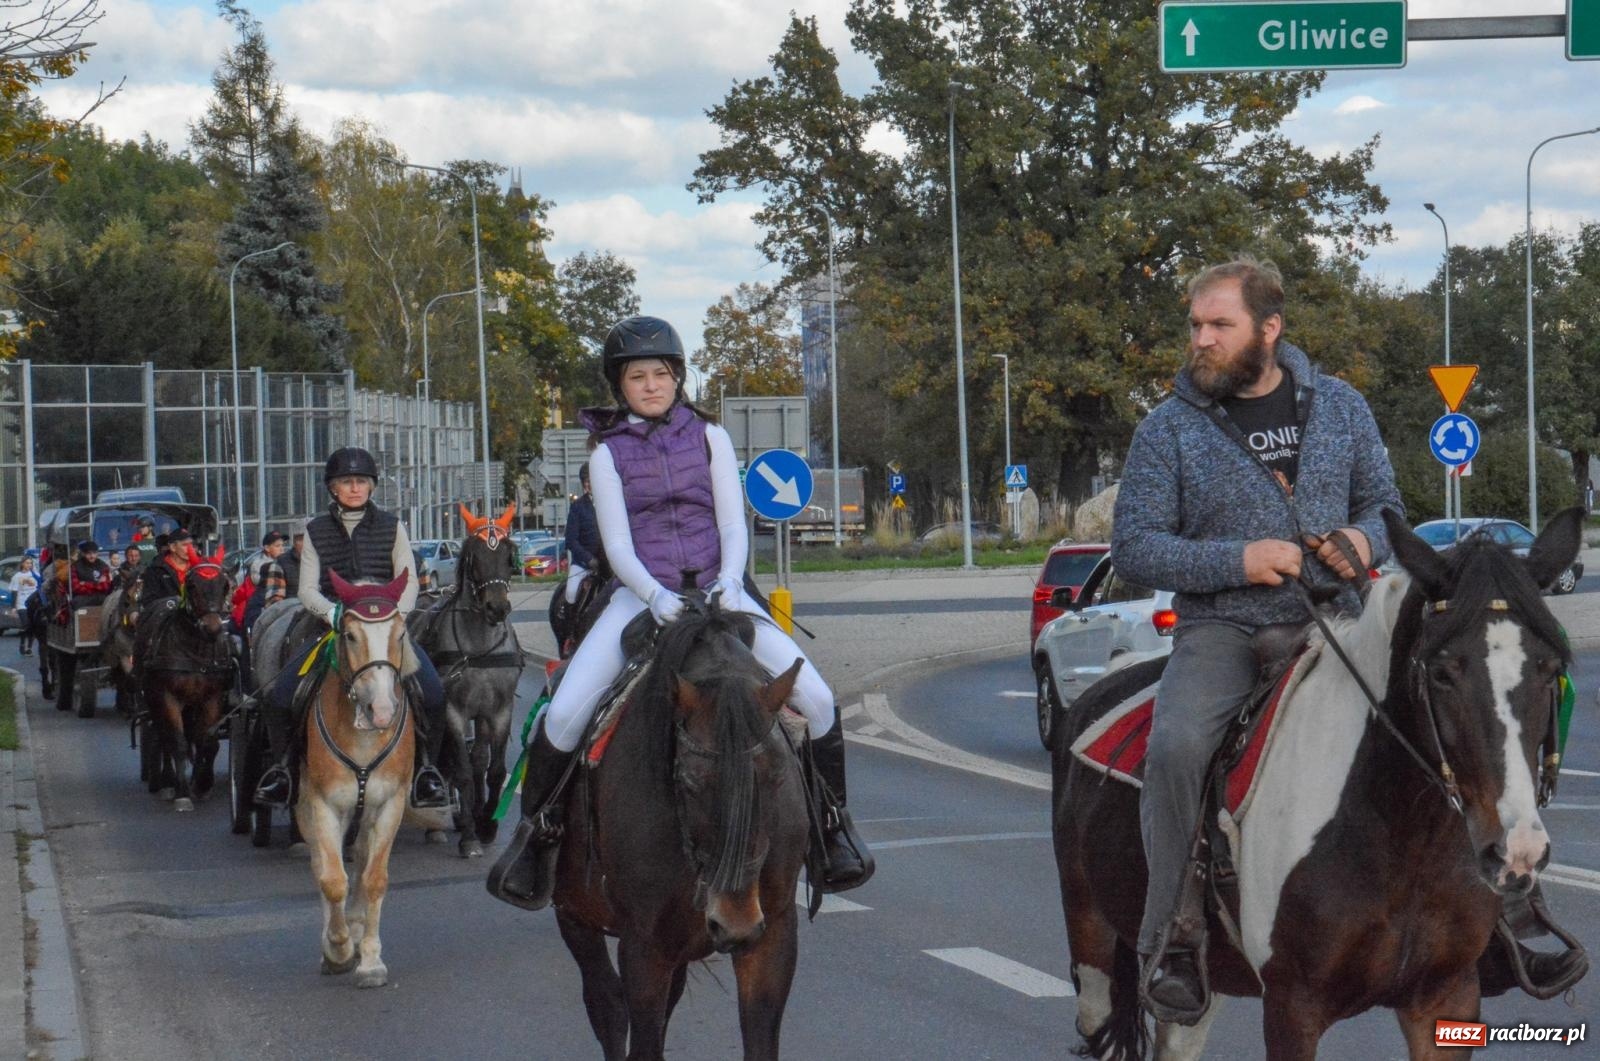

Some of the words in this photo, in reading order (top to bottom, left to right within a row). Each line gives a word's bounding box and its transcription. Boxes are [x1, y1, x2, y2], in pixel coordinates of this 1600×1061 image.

[1258, 19, 1389, 51] Gliwice
[1244, 426, 1299, 450] ONIE
[893, 476, 902, 488] P
